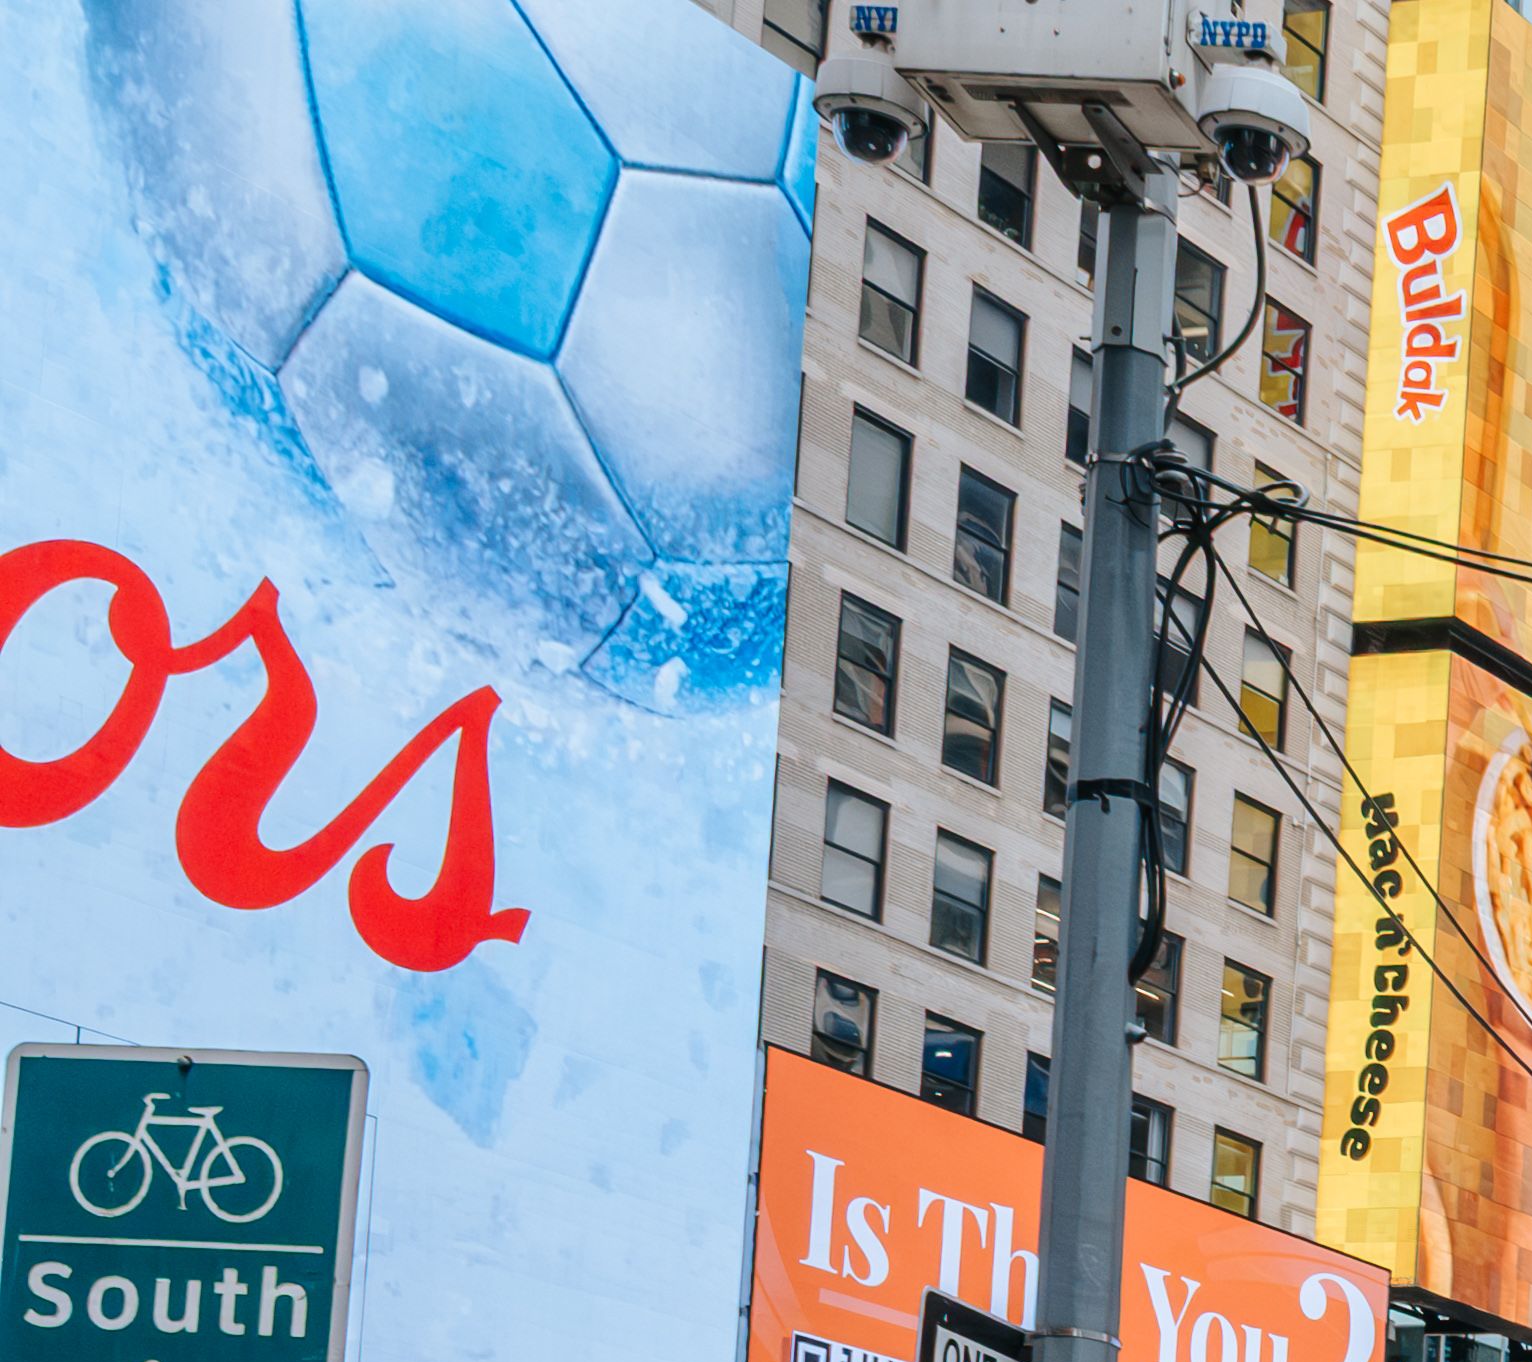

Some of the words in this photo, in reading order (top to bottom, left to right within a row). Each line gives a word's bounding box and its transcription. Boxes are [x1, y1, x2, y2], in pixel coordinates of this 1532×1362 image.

[1200, 17, 1267, 50] NYPD
[1381, 180, 1466, 426] Buldak
[1340, 963, 1411, 1162] Cheese
[798, 1149, 892, 1287] Is
[23, 1261, 309, 1338] South
